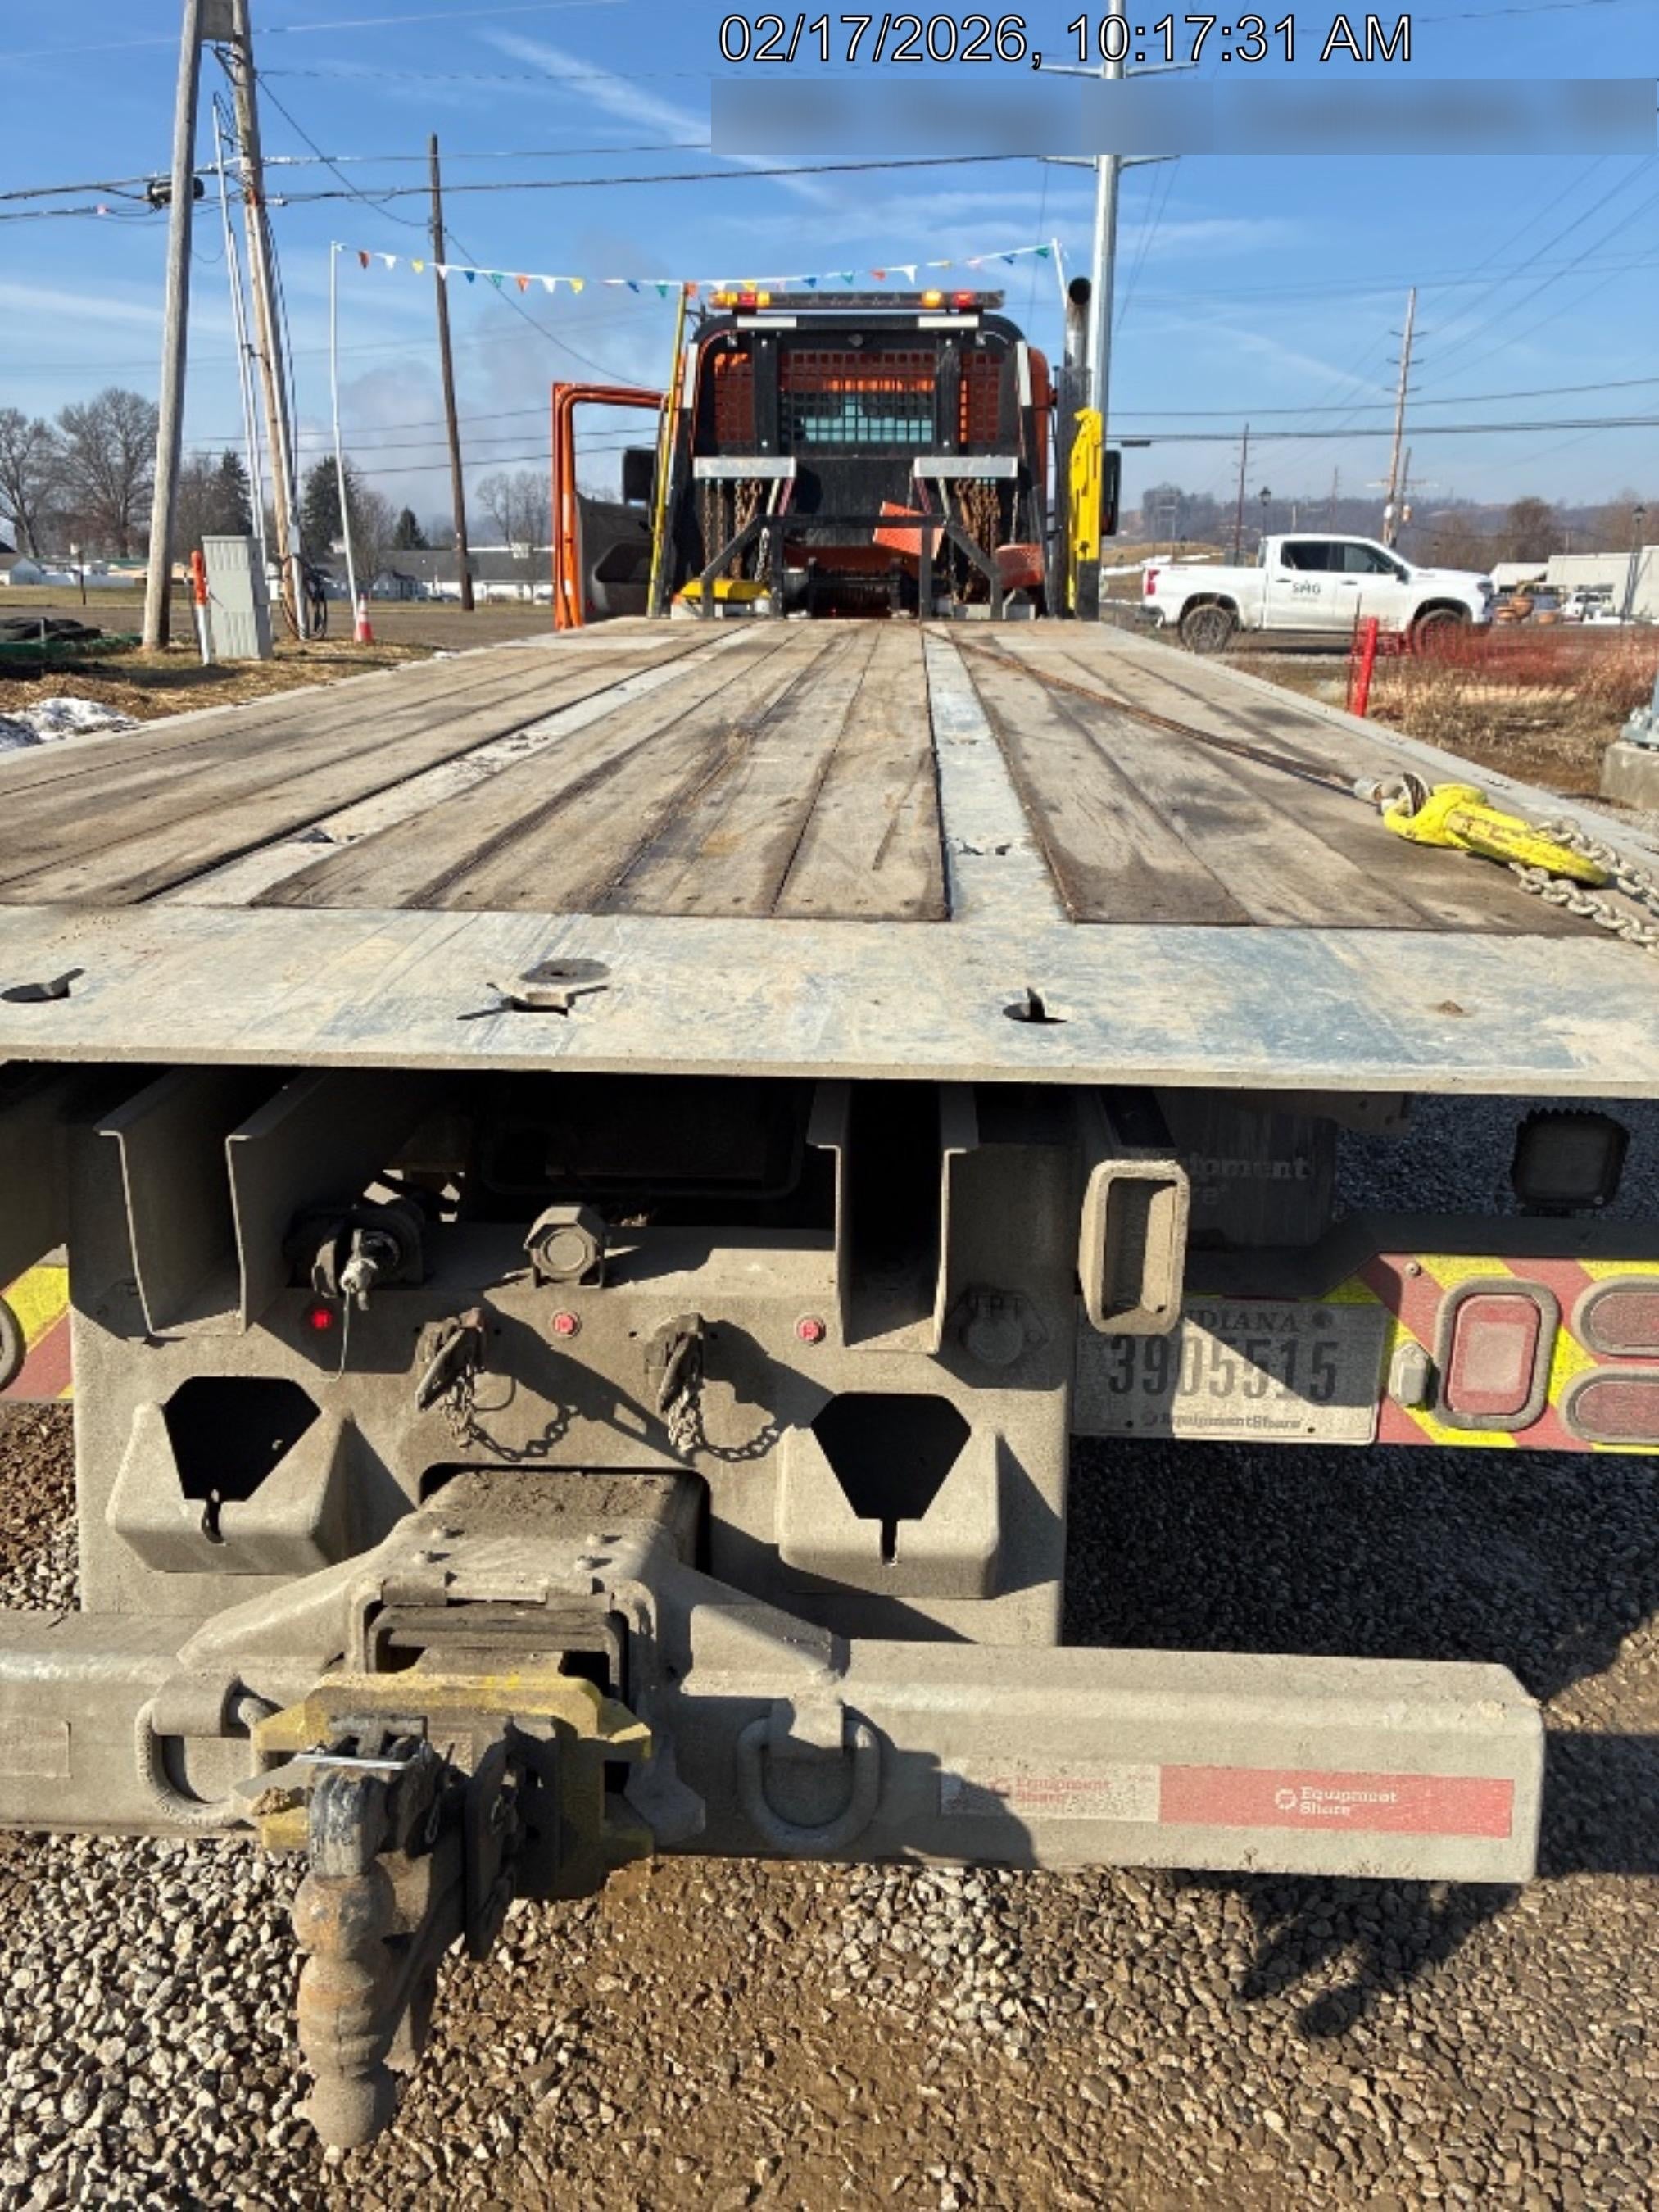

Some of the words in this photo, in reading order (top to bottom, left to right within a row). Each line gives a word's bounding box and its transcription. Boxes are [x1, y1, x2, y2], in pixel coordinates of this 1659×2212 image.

[1186, 1308, 1300, 1333] DIANA
[1108, 1334, 1339, 1402] 3905515
[1299, 1785, 1397, 1804] Equipment
[1299, 1801, 1351, 1815] Share
